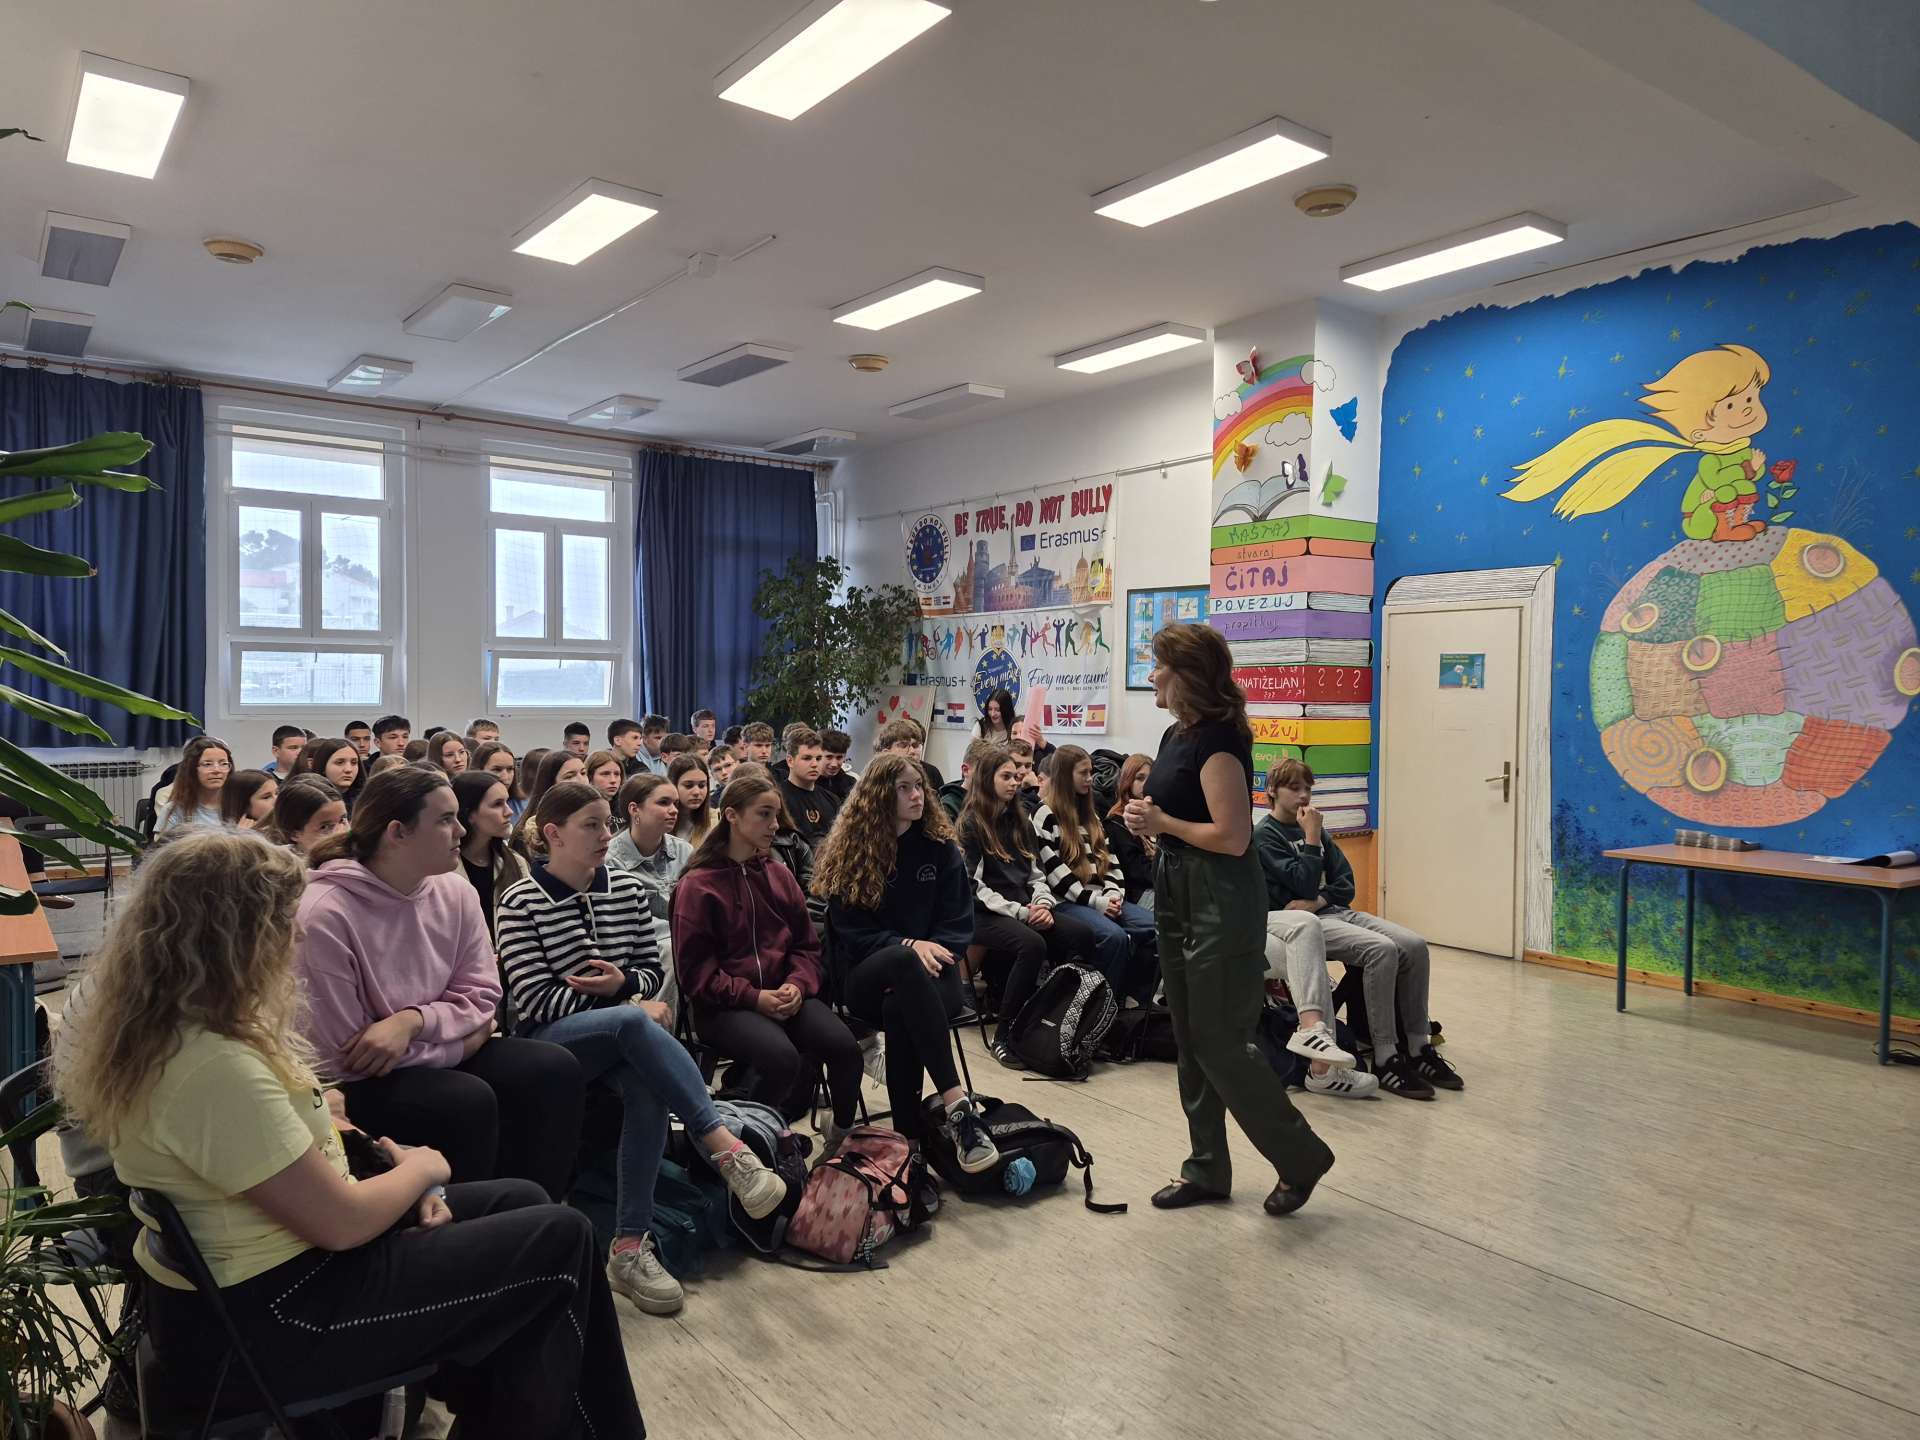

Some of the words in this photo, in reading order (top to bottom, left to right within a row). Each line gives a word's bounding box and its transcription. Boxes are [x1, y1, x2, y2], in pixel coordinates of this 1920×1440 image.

[954, 512, 969, 537] BE
[975, 505, 1009, 534] TRUE,
[1015, 500, 1034, 528] DO
[1039, 494, 1065, 524] NOT
[1071, 483, 1113, 518] BULLY
[1215, 594, 1294, 612] POVEZUJ
[919, 673, 967, 687] Erasmus+
[1027, 667, 1054, 691] Every
[1055, 674, 1081, 685] move
